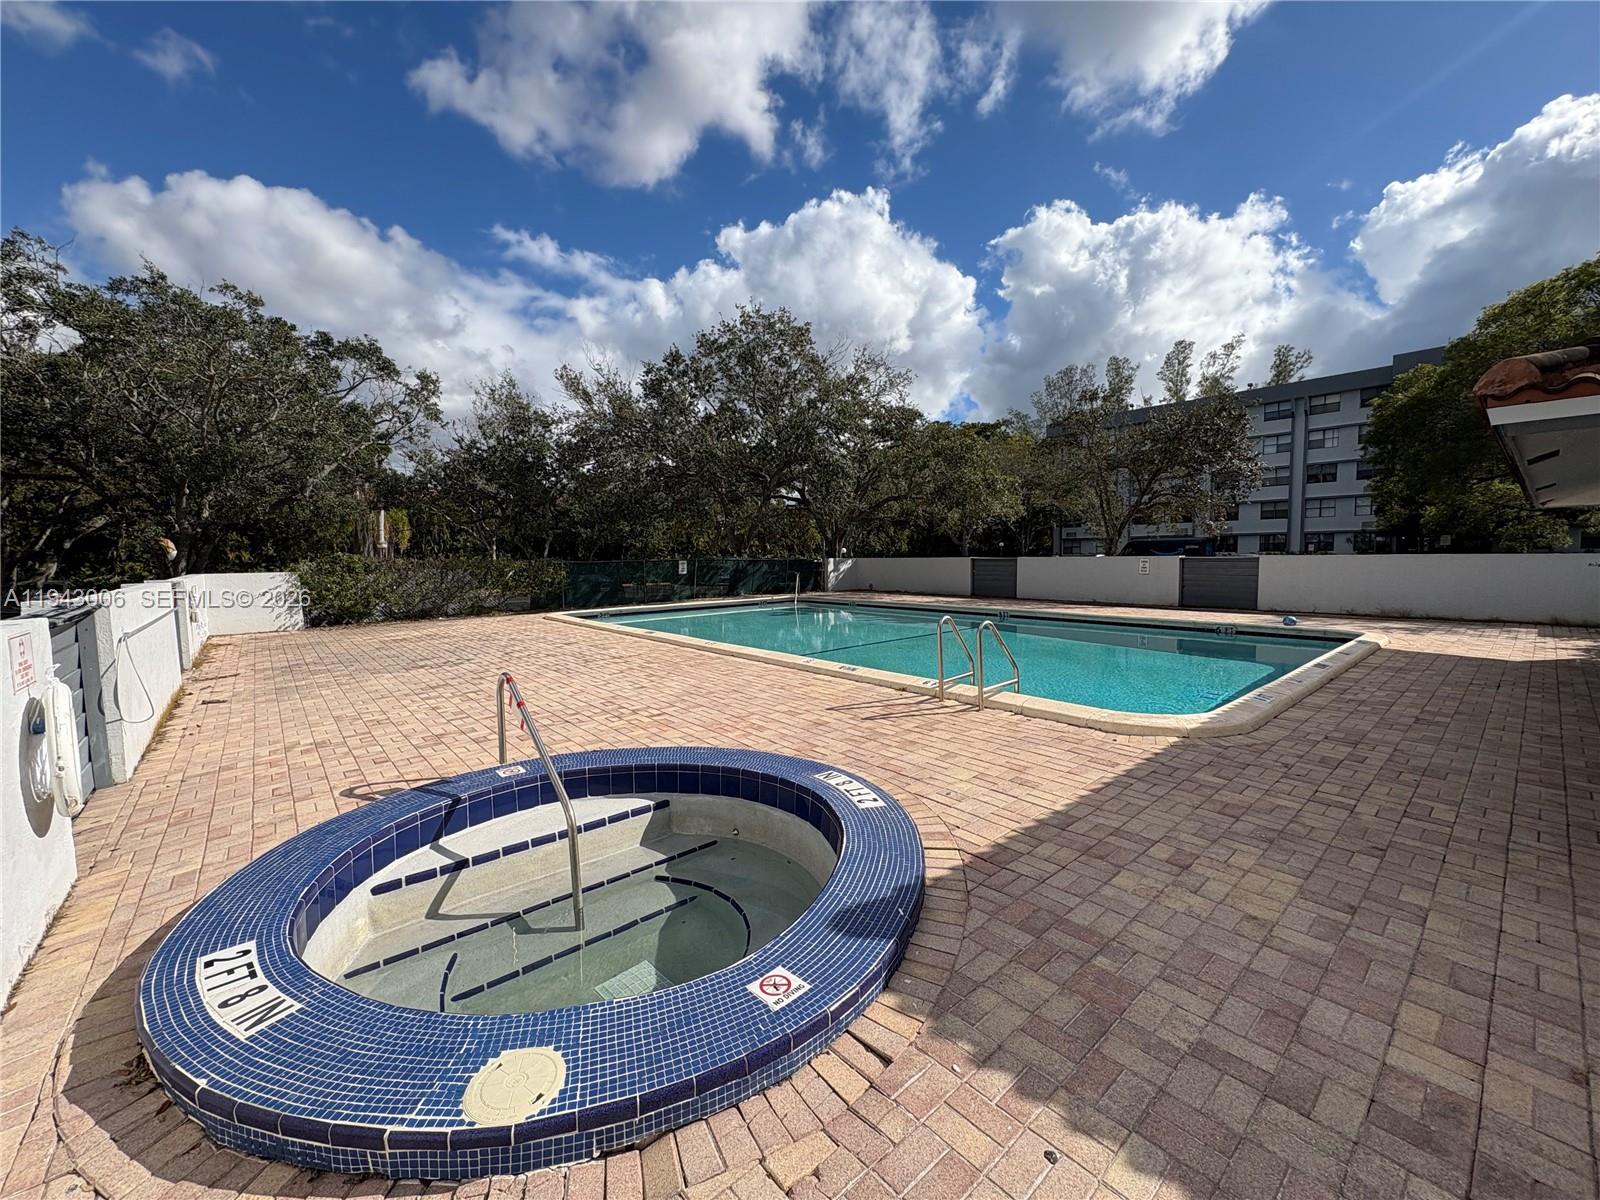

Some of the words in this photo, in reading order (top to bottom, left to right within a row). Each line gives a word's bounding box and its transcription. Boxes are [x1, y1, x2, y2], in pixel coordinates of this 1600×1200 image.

[817, 771, 842, 781] IN
[835, 779, 854, 787] 8
[843, 787, 871, 798] FT
[203, 948, 252, 969] 2
[204, 961, 258, 992] FT
[217, 984, 269, 1009] 8
[772, 997, 784, 1006] NO
[783, 983, 806, 1000] DIVING
[231, 995, 295, 1032] IN
